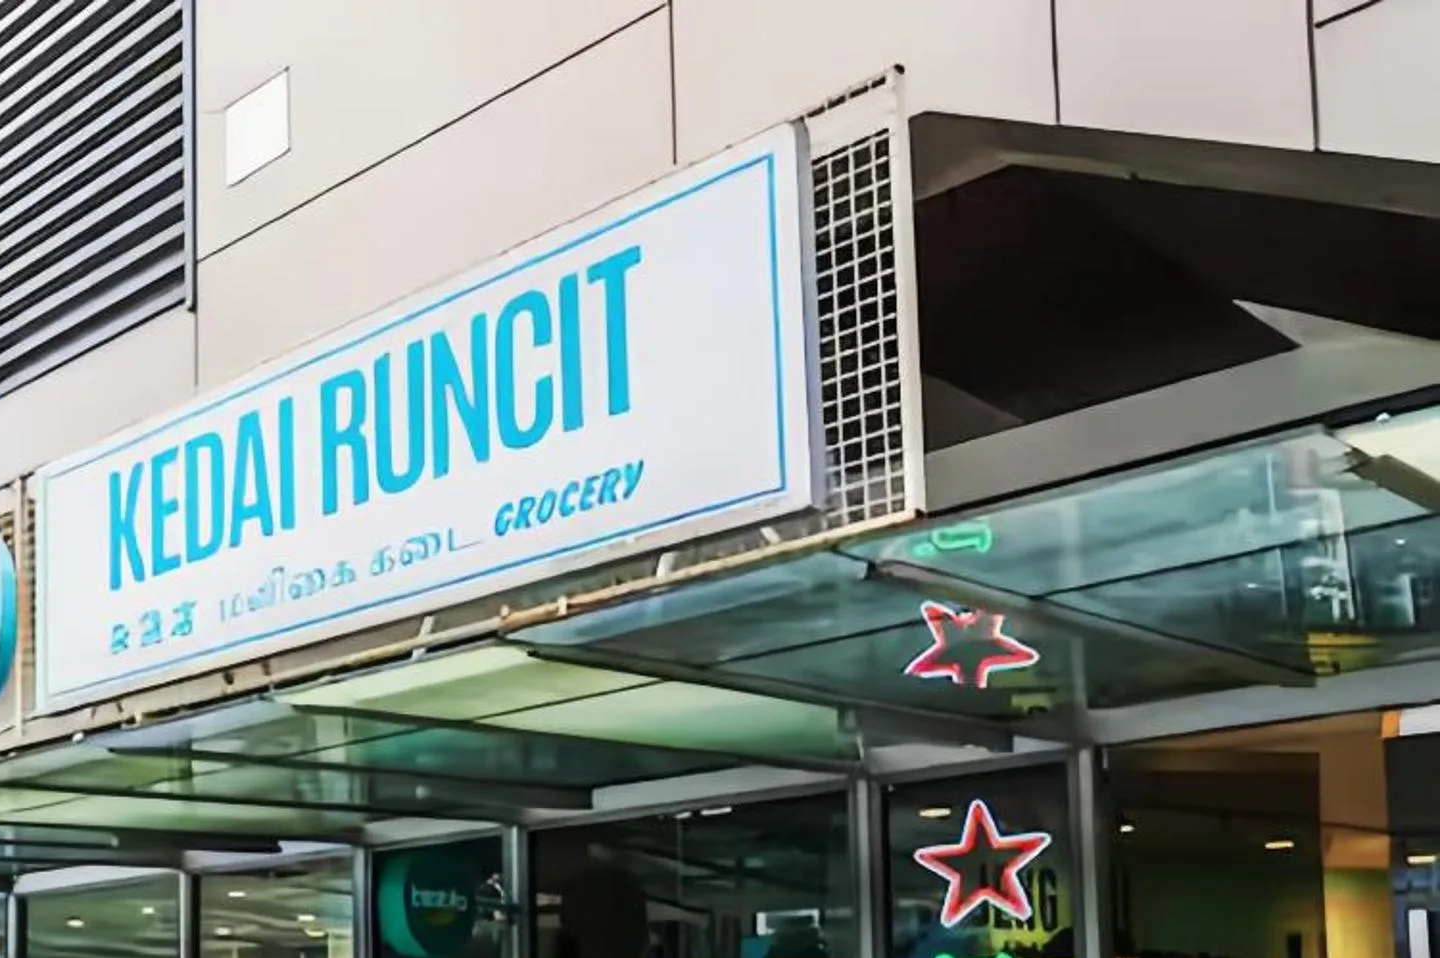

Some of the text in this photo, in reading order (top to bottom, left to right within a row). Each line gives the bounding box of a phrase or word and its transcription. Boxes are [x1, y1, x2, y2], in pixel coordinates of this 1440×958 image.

[107, 244, 645, 593] KEDAI RUNCIT
[493, 460, 646, 539] GROCERY
